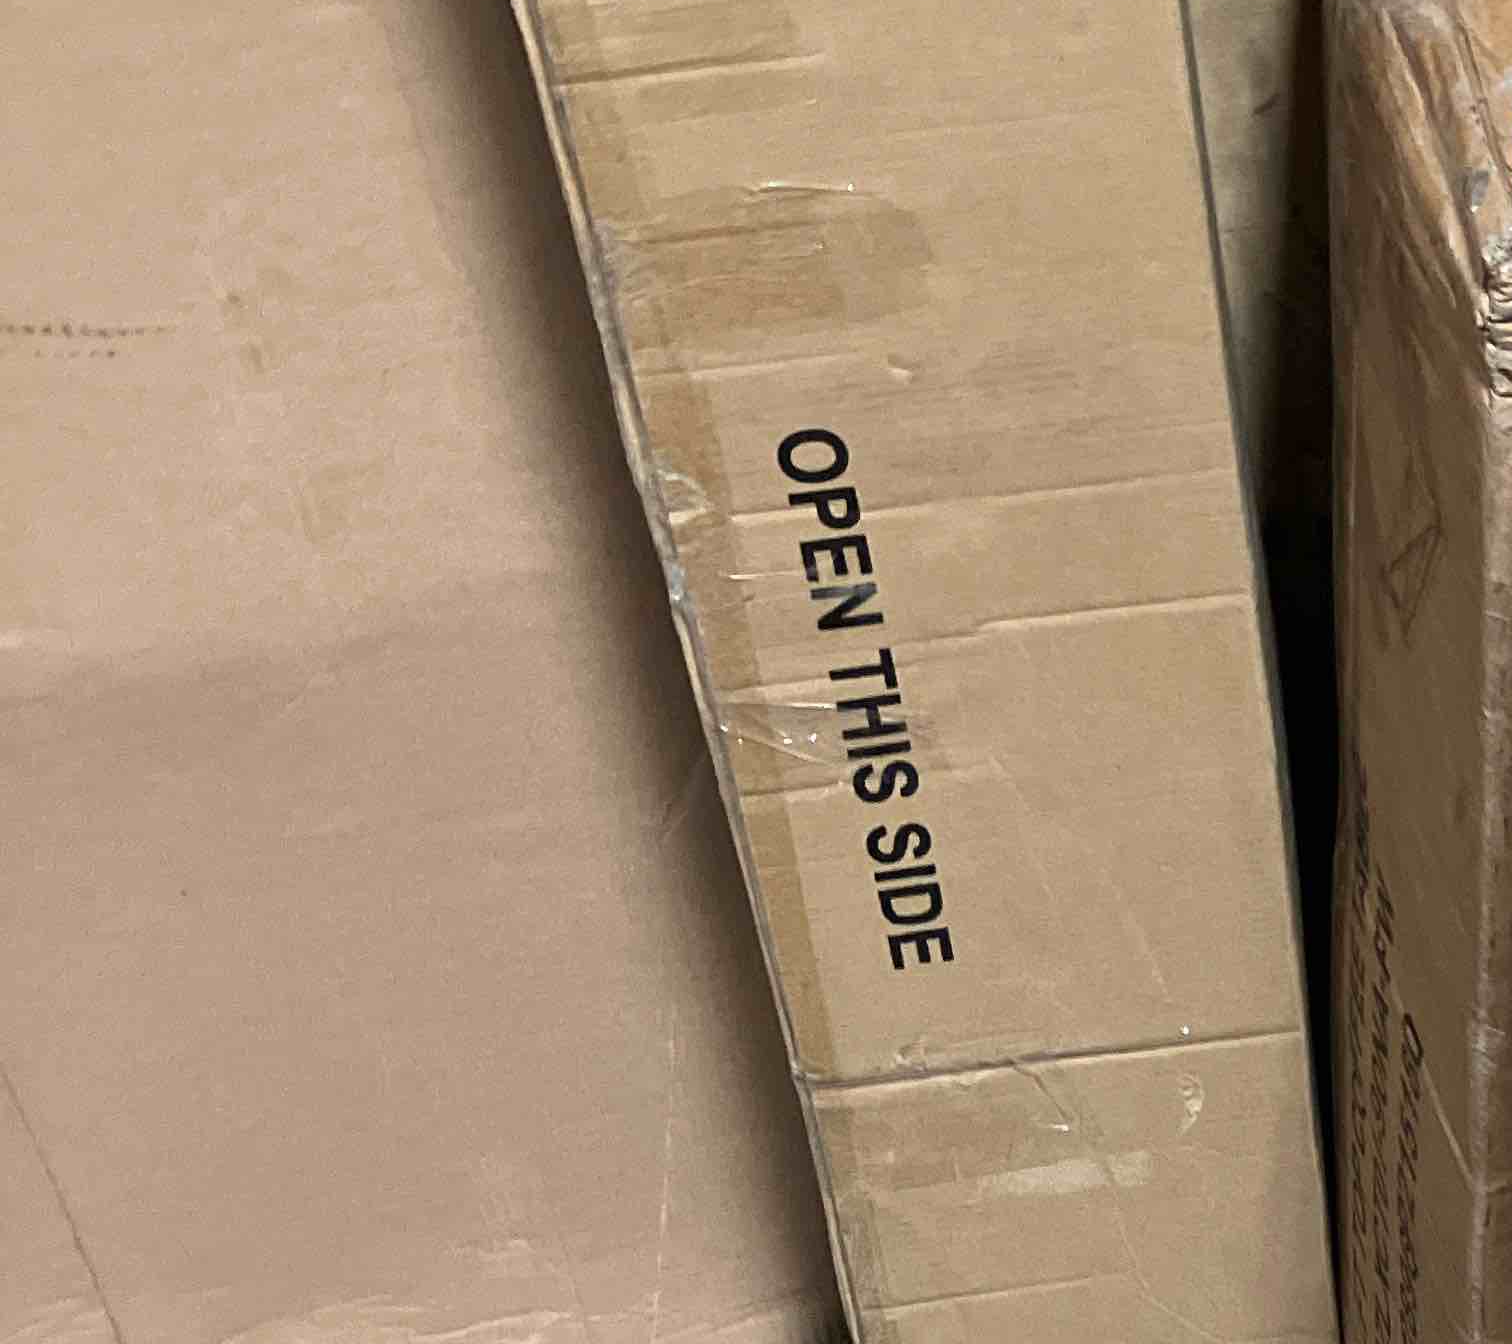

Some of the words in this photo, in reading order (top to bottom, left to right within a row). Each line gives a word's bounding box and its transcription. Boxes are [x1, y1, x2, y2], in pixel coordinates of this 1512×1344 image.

[777, 429, 884, 631] OPEN
[829, 648, 919, 803] THIS
[866, 822, 955, 970] SIDE
